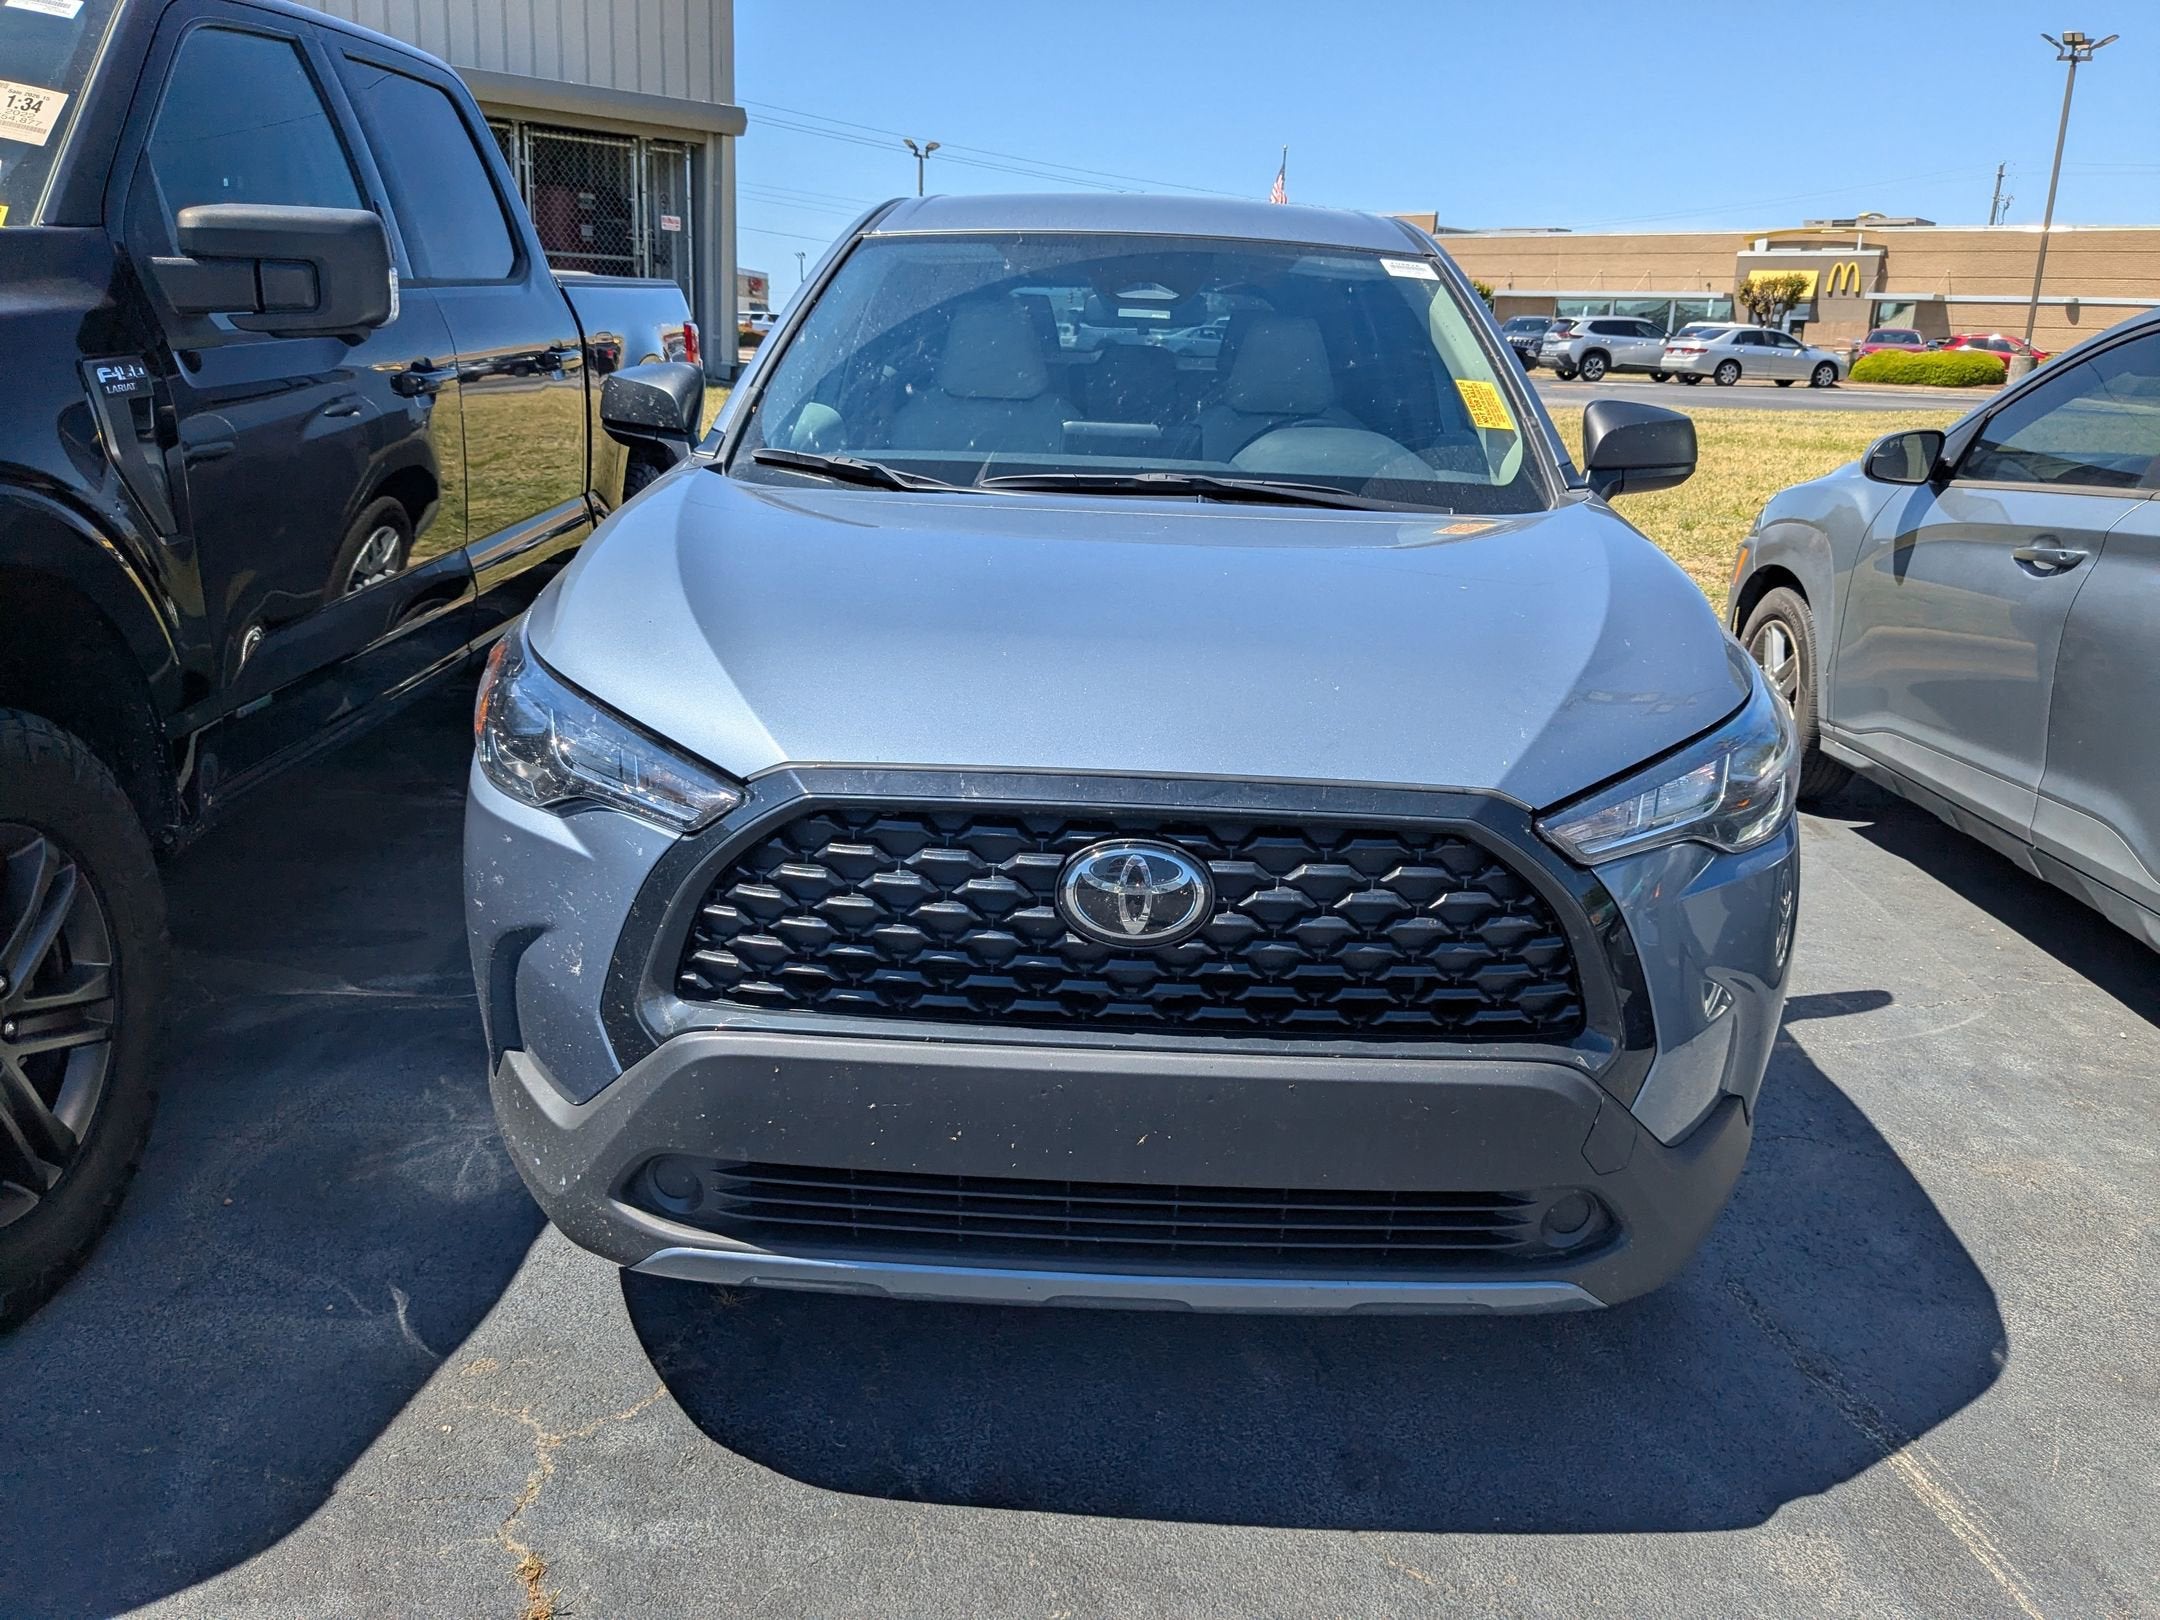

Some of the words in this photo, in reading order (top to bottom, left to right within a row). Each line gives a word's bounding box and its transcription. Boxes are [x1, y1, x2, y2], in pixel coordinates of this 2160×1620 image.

[7, 95, 43, 113] 1:34
[5, 109, 36, 119] 2022
[106, 382, 136, 394] LARIAT
